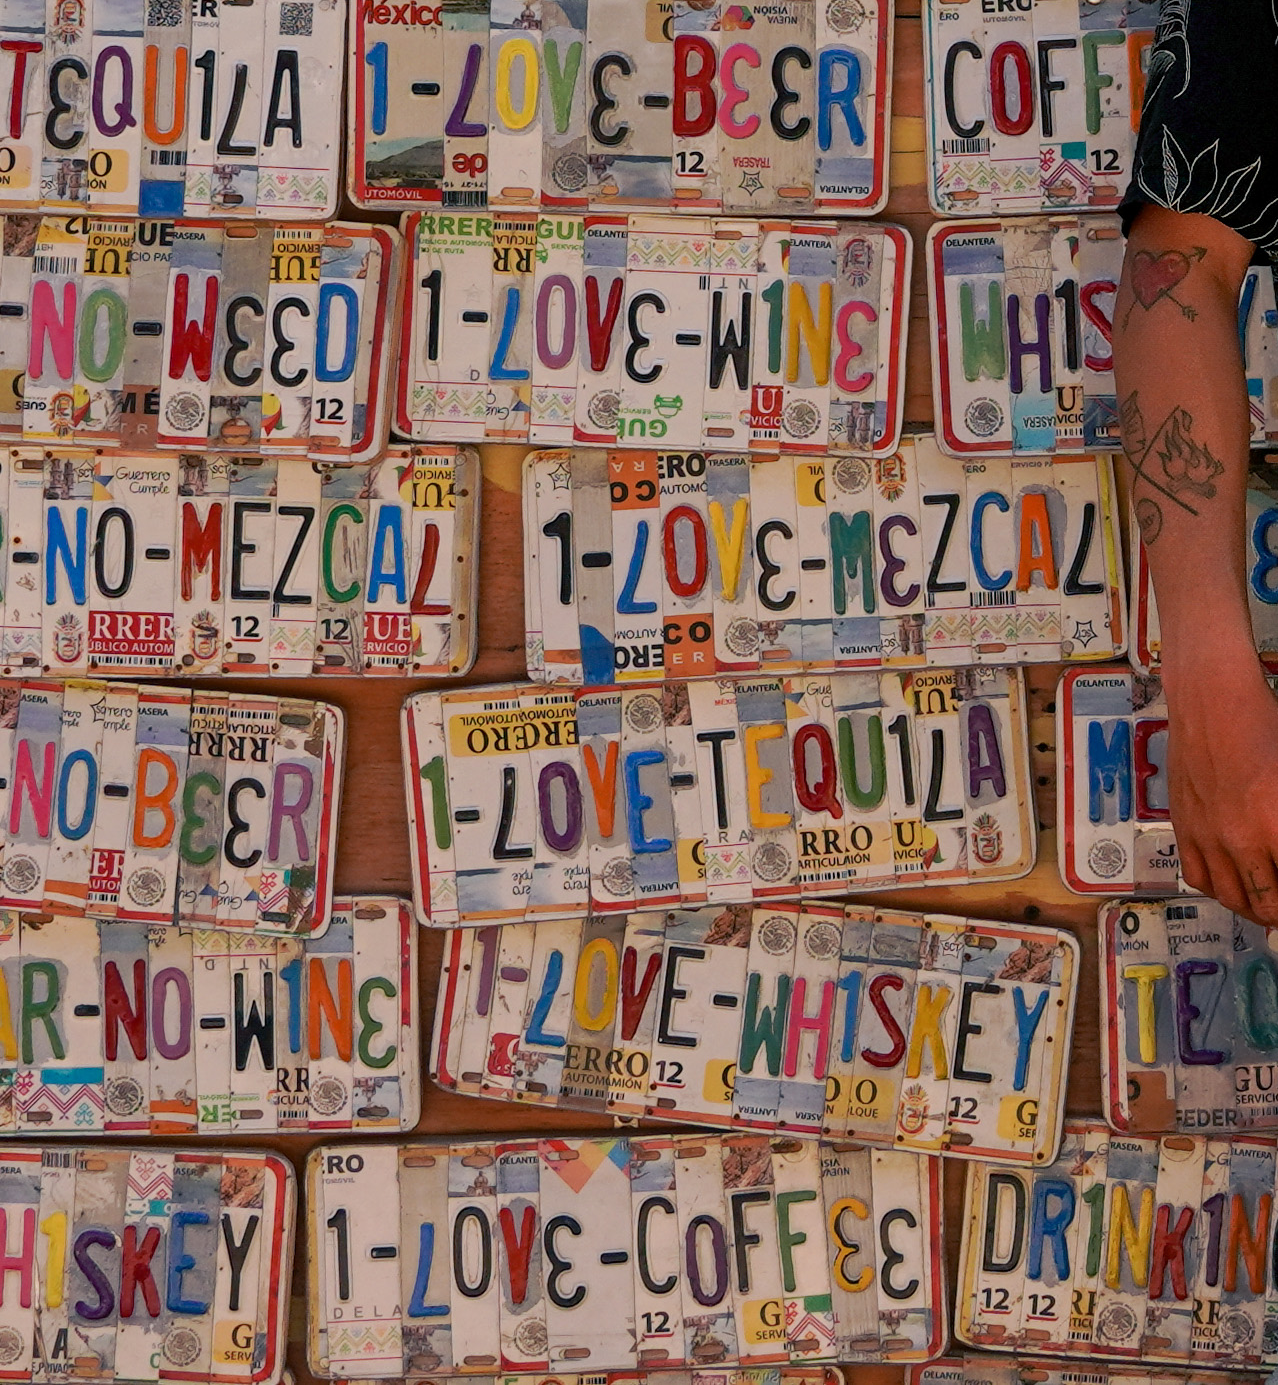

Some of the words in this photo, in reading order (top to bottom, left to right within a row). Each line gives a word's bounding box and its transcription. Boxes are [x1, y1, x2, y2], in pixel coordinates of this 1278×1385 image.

[675, 151, 705, 173] 12
[1090, 148, 1121, 172] 12
[315, 397, 344, 422] 12
[320, 616, 351, 641] 12
[655, 1060, 684, 1084] 12
[948, 1096, 978, 1120] 12
[981, 1287, 1010, 1311] 12
[641, 1311, 671, 1334] 12
